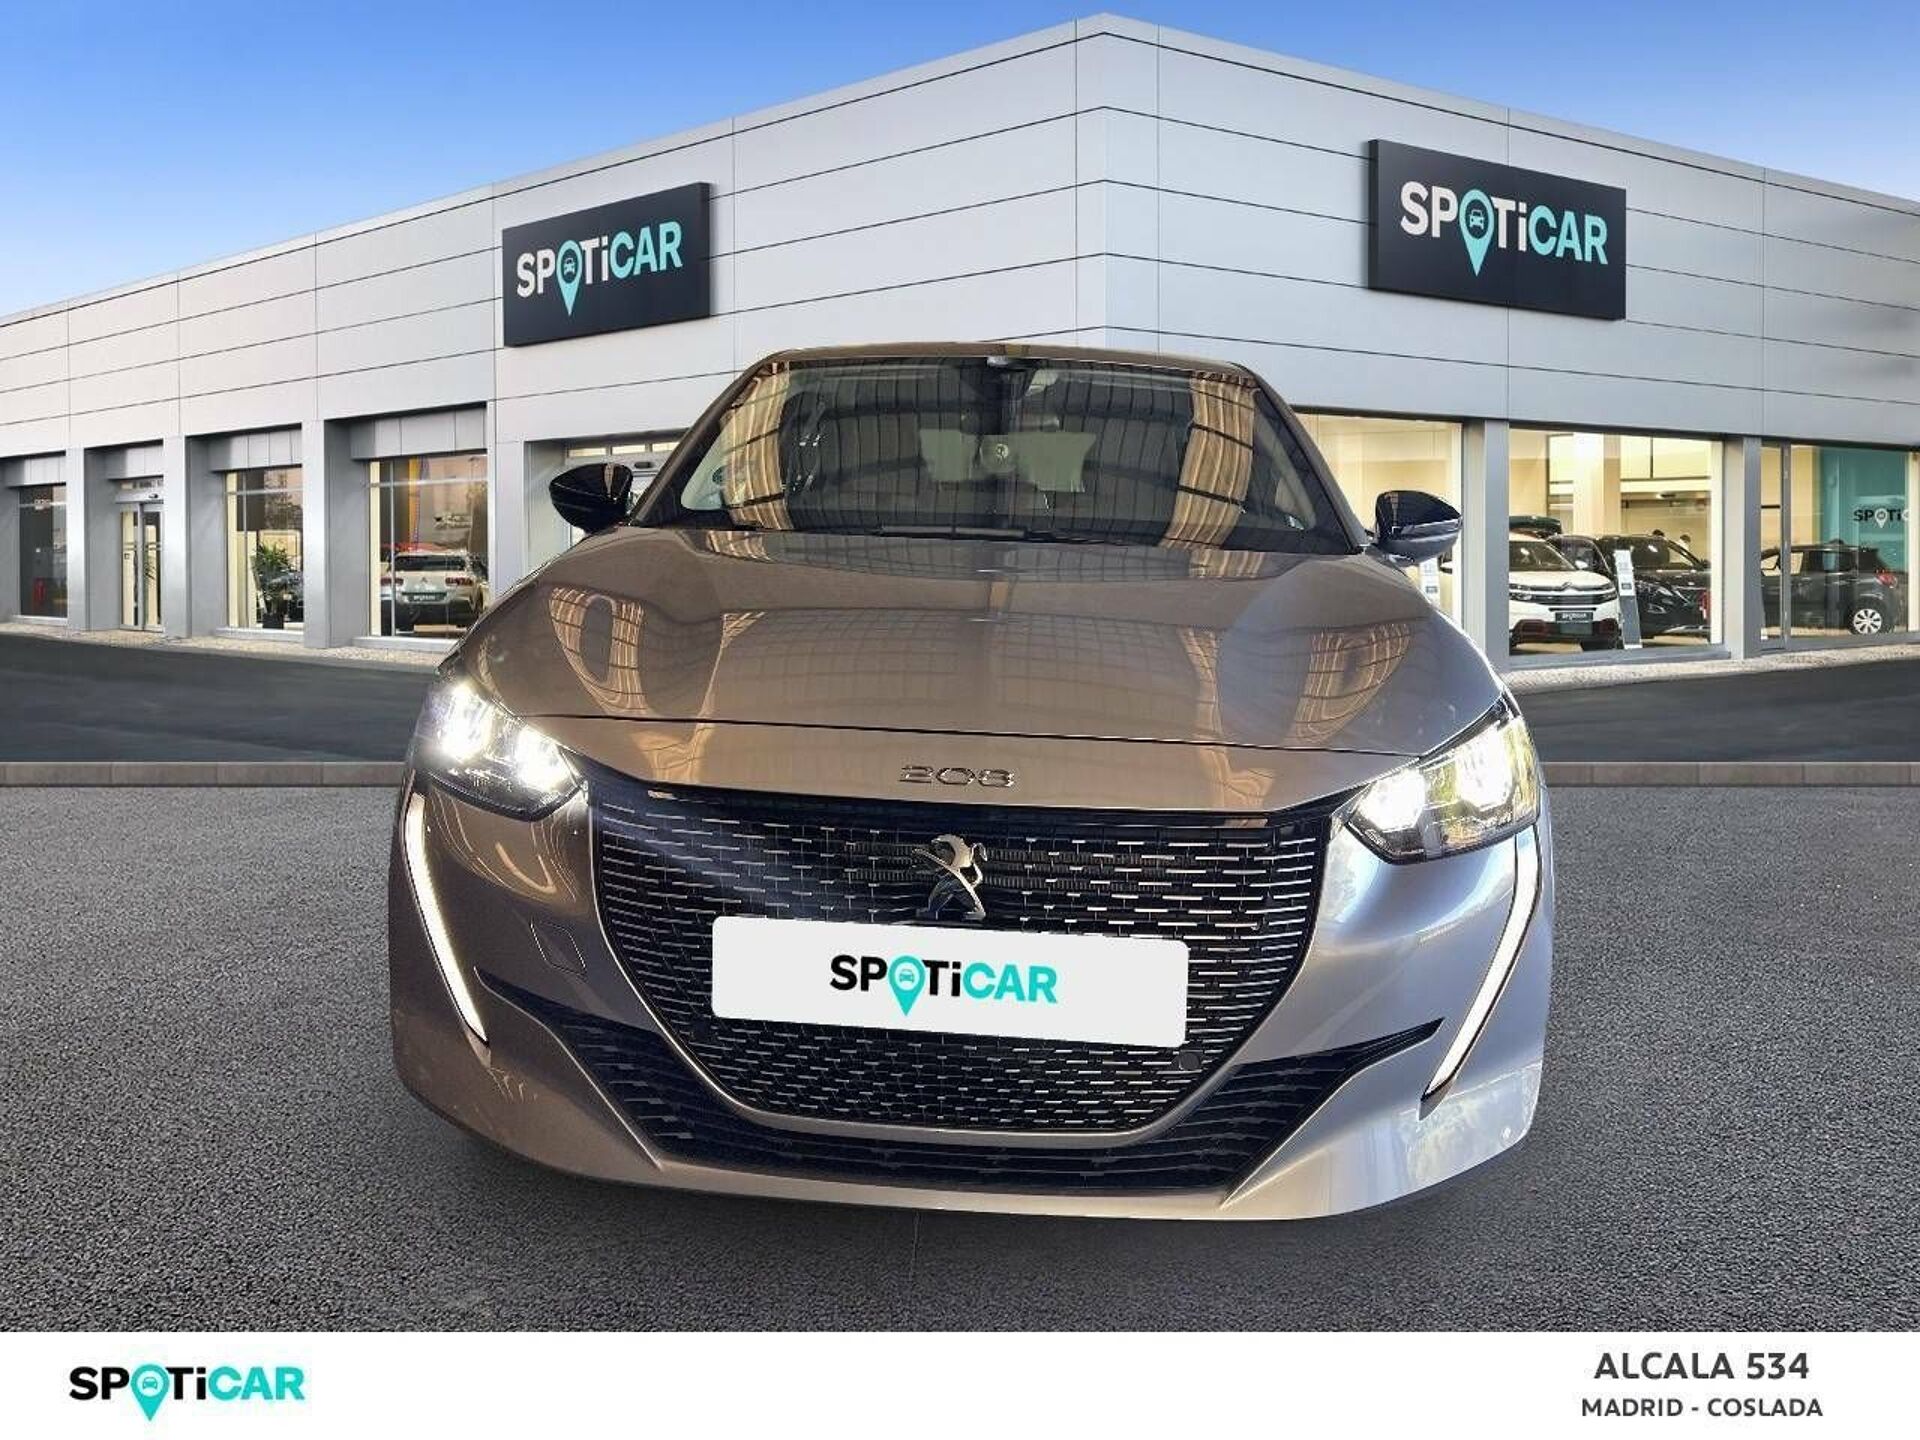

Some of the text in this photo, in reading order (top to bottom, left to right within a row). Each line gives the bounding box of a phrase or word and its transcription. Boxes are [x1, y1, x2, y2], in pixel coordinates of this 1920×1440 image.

[516, 221, 683, 316] SPOTiCAR
[1400, 181, 1609, 277] SPOTiCAR
[899, 765, 1015, 788] 208
[830, 954, 1057, 1017] SPOTiCAR
